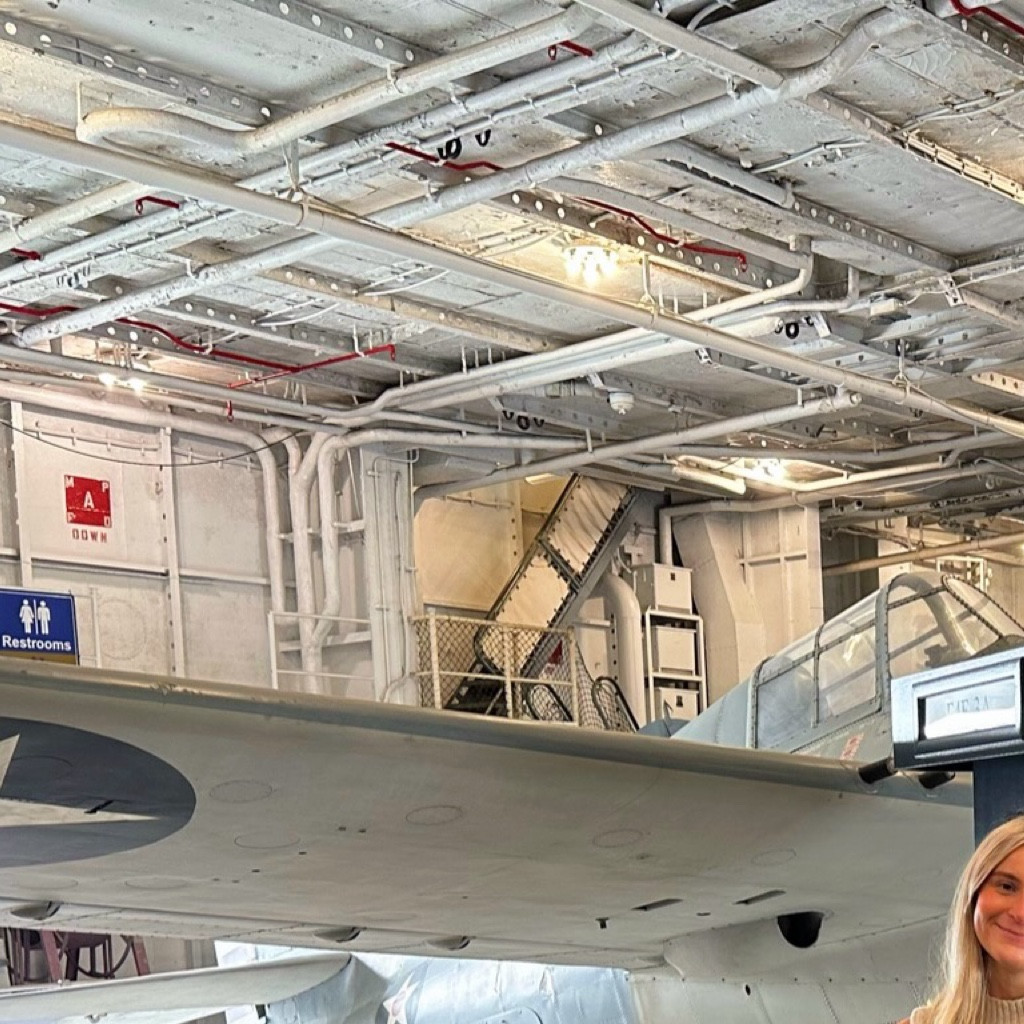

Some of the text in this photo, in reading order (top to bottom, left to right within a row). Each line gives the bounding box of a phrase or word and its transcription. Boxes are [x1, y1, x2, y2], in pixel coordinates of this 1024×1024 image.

[66, 477, 75, 488] M
[102, 482, 109, 493] P
[83, 491, 95, 509] A
[2, 634, 72, 651] Restrooms
